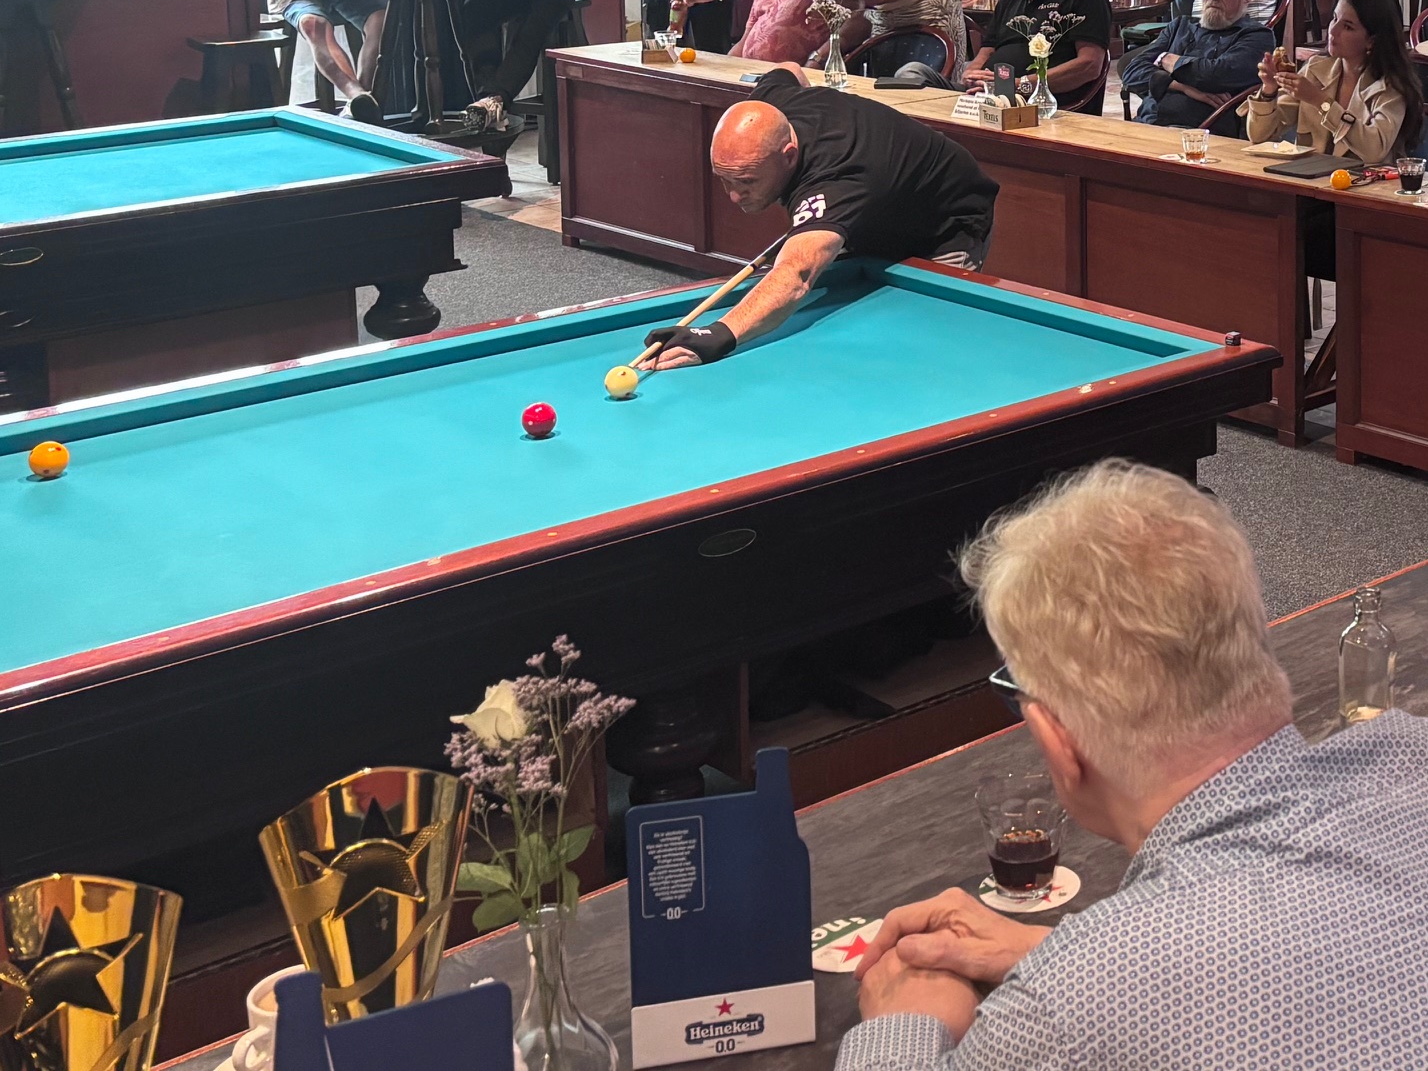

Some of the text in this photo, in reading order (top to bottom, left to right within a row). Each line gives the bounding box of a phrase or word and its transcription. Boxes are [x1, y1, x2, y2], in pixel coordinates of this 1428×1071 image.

[982, 109, 999, 122] TEXELS
[689, 1018, 761, 1041] Heineken
[715, 1038, 736, 1054] 0.0
